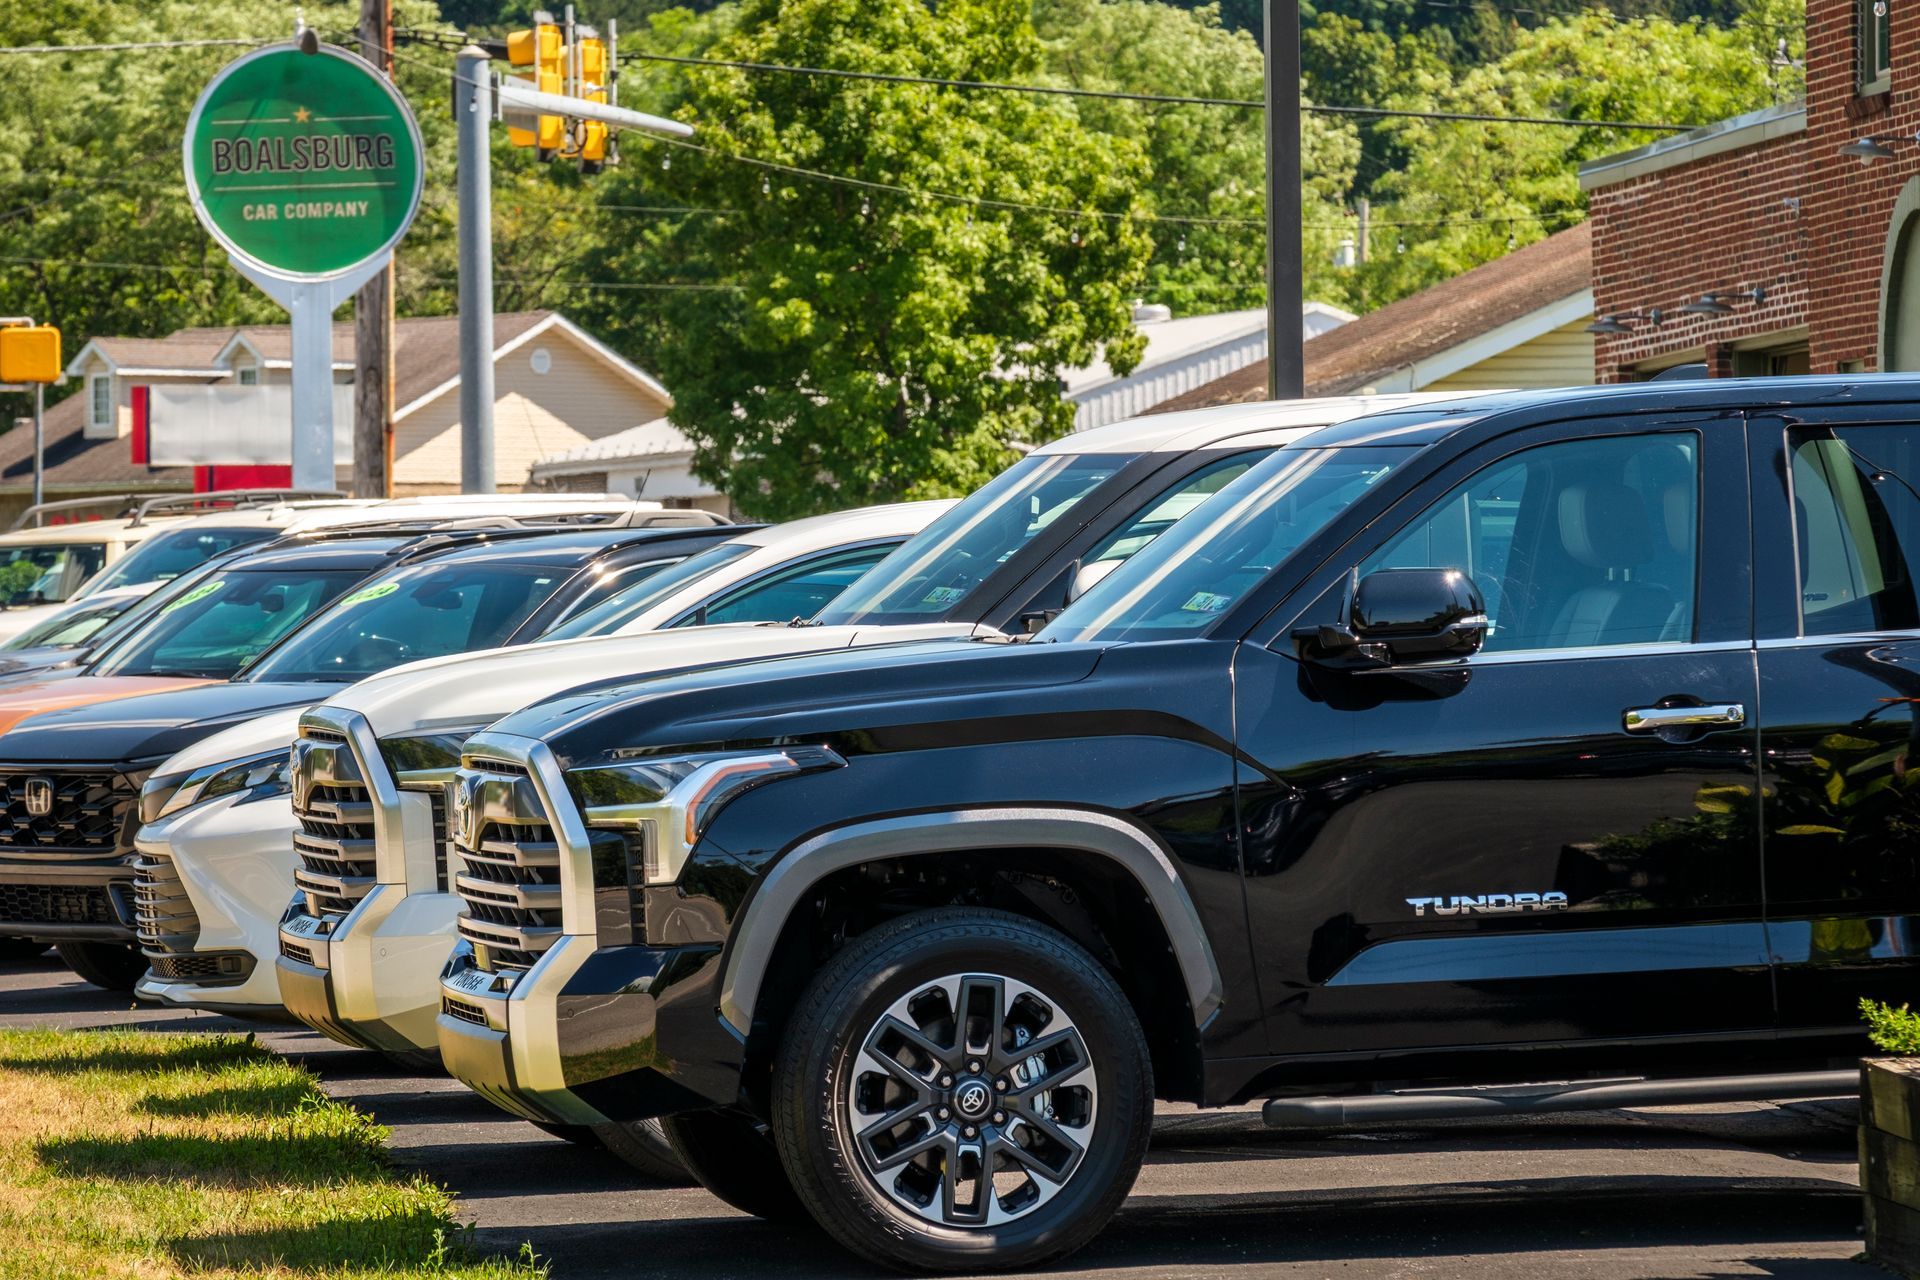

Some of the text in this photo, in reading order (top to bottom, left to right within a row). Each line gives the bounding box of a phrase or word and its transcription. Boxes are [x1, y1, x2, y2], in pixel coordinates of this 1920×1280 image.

[212, 134, 395, 174] BOALSBURG
[242, 201, 369, 221] CAR COMPANY
[1405, 892, 1568, 916] TUNDRA
